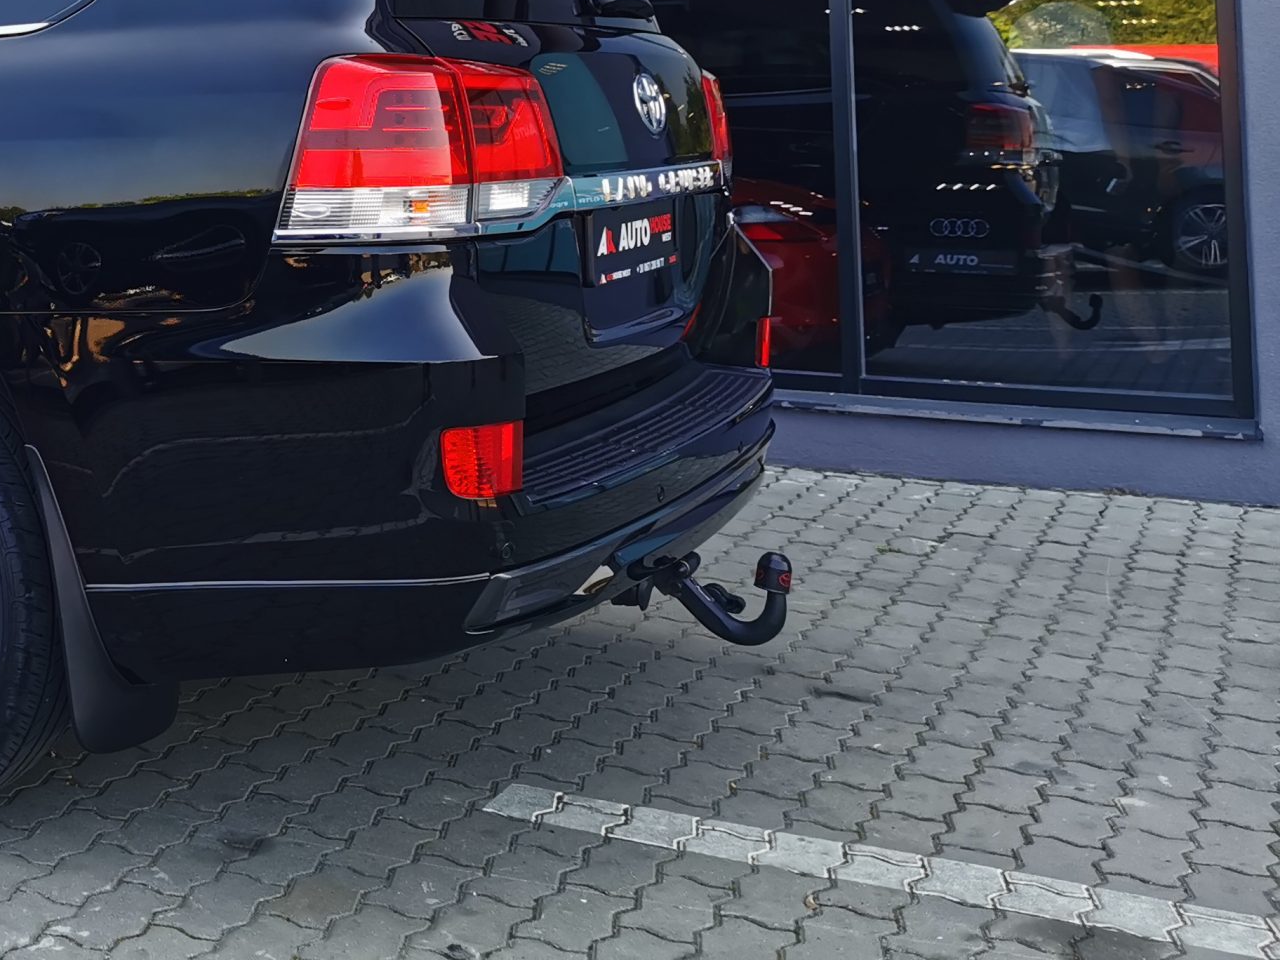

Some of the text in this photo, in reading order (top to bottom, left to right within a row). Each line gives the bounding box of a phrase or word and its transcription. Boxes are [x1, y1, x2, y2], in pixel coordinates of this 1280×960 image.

[619, 218, 651, 252] AUTO
[650, 213, 673, 235] HOUSE
[934, 253, 979, 266] AUTO
